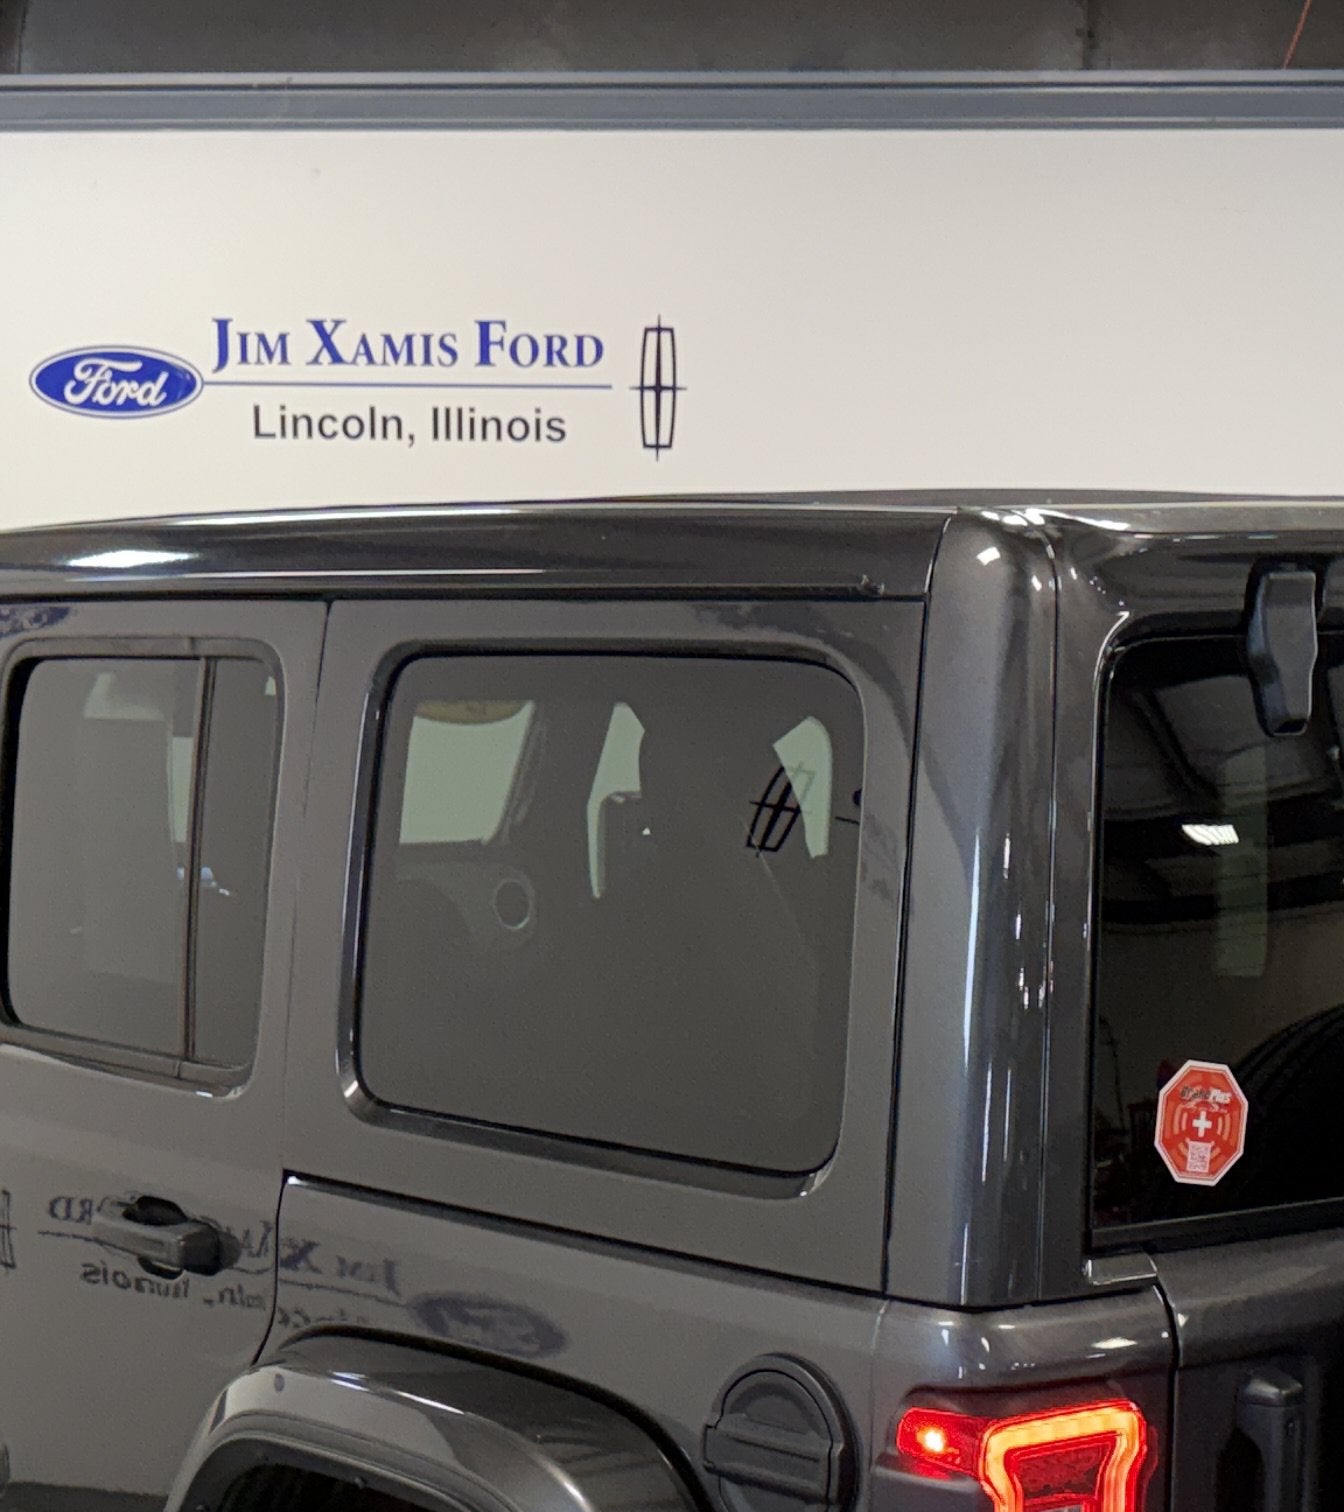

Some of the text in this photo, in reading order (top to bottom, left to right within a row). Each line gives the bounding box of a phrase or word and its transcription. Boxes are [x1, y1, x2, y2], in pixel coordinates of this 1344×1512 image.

[212, 318, 605, 374] JIM XAMIS FORD
[63, 357, 168, 408] Ford
[252, 405, 567, 449] Lincoln, Illinois
